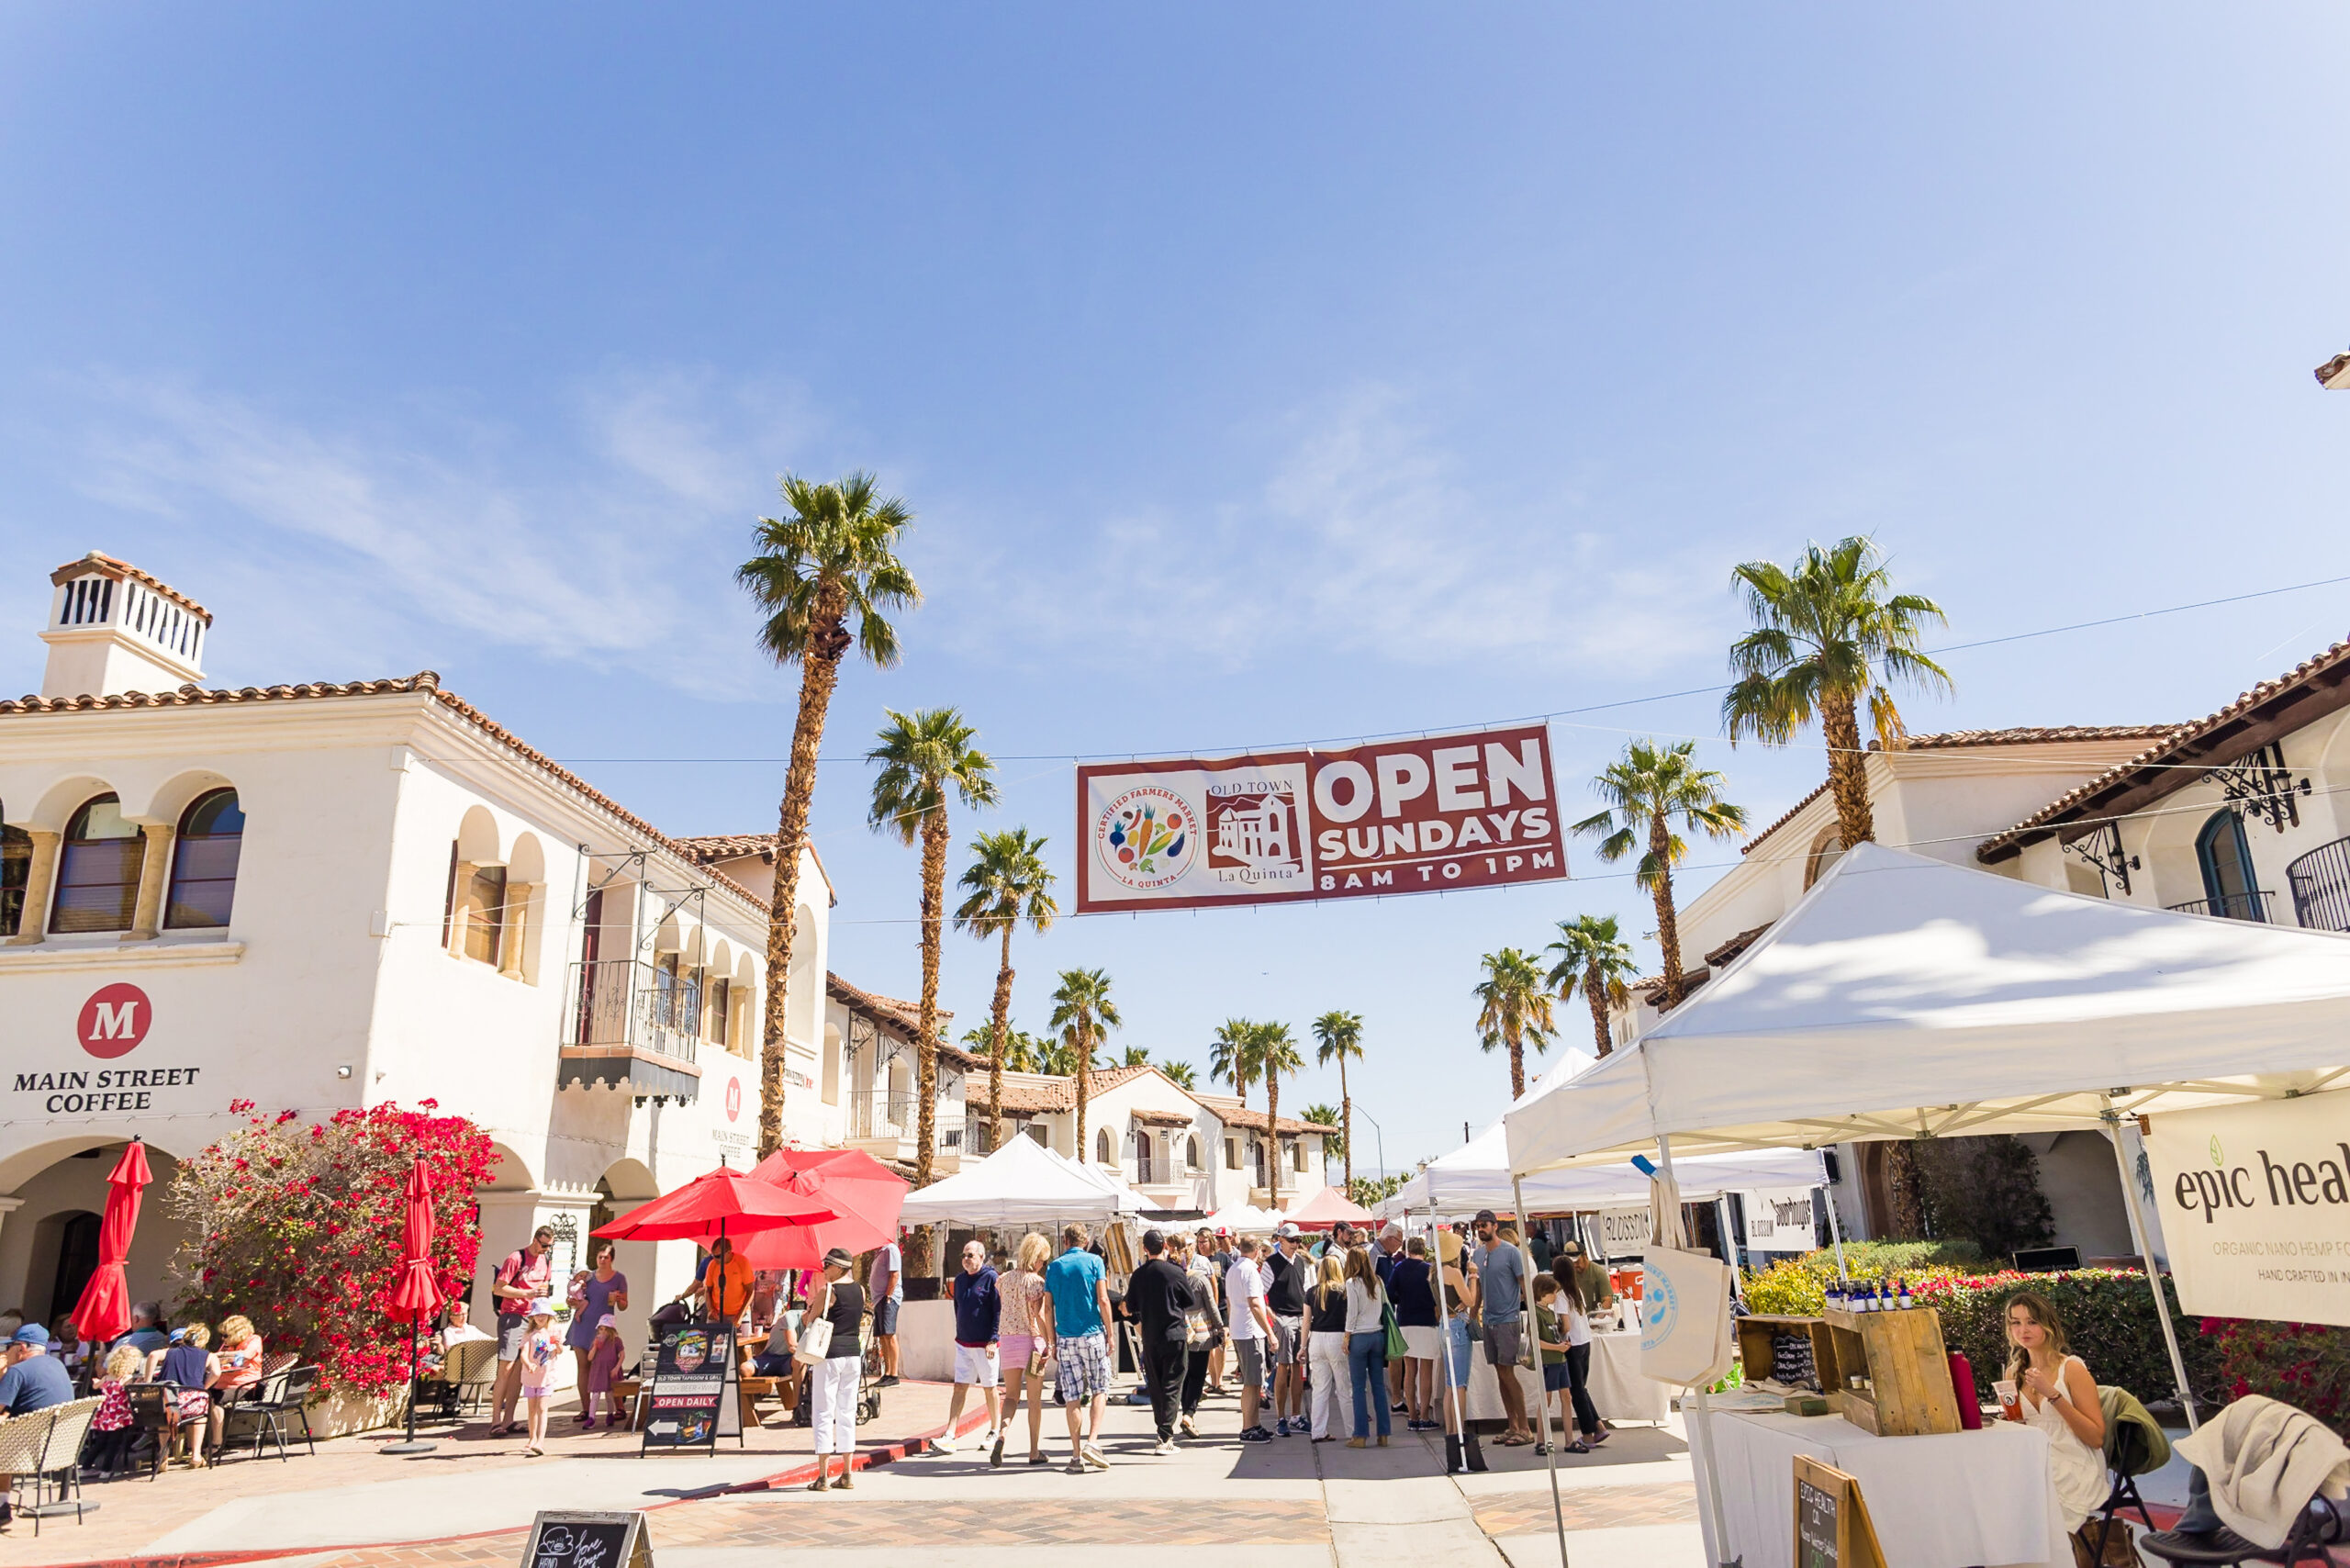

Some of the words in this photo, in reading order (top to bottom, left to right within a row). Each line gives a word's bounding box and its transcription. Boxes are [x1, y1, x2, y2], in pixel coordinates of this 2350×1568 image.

[1212, 783, 1241, 795] OLD
[1248, 779, 1292, 792] TOWN
[1314, 738, 1547, 823] OPEN
[1098, 795, 1128, 839] CERTIFIED
[1130, 788, 1175, 801] FARMERS
[1174, 799, 1197, 835] MARKET
[1317, 807, 1551, 861] SUNDAYS
[1219, 869, 1235, 881] La
[1239, 868, 1292, 884] Quinta
[1320, 869, 1393, 890] 8AM
[1417, 862, 1461, 882] TO
[1485, 851, 1555, 875] 1PM
[1122, 876, 1134, 886] LA
[1138, 875, 1177, 889] QUINTA
[88, 1001, 139, 1041] M
[13, 1070, 90, 1092] MAIN
[96, 1068, 200, 1088] STREET
[46, 1092, 151, 1113] COFFEE
[2175, 1137, 2255, 1224] epic
[2213, 1241, 2264, 1255] ORGANIC
[2266, 1241, 2297, 1256] NANO
[2300, 1241, 2332, 1256] HEMP
[2258, 1269, 2284, 1281] HAND
[2285, 1269, 2325, 1282] CRAFTED
[2328, 1271, 2338, 1282] IN
[657, 1384, 677, 1393] FOOD
[681, 1383, 697, 1392] BEER
[701, 1383, 719, 1391] WINE
[658, 1397, 684, 1407] OPEN
[687, 1397, 715, 1406] DAILY
[1800, 1481, 1814, 1504] EPIC
[1814, 1490, 1836, 1518] HEALTH
